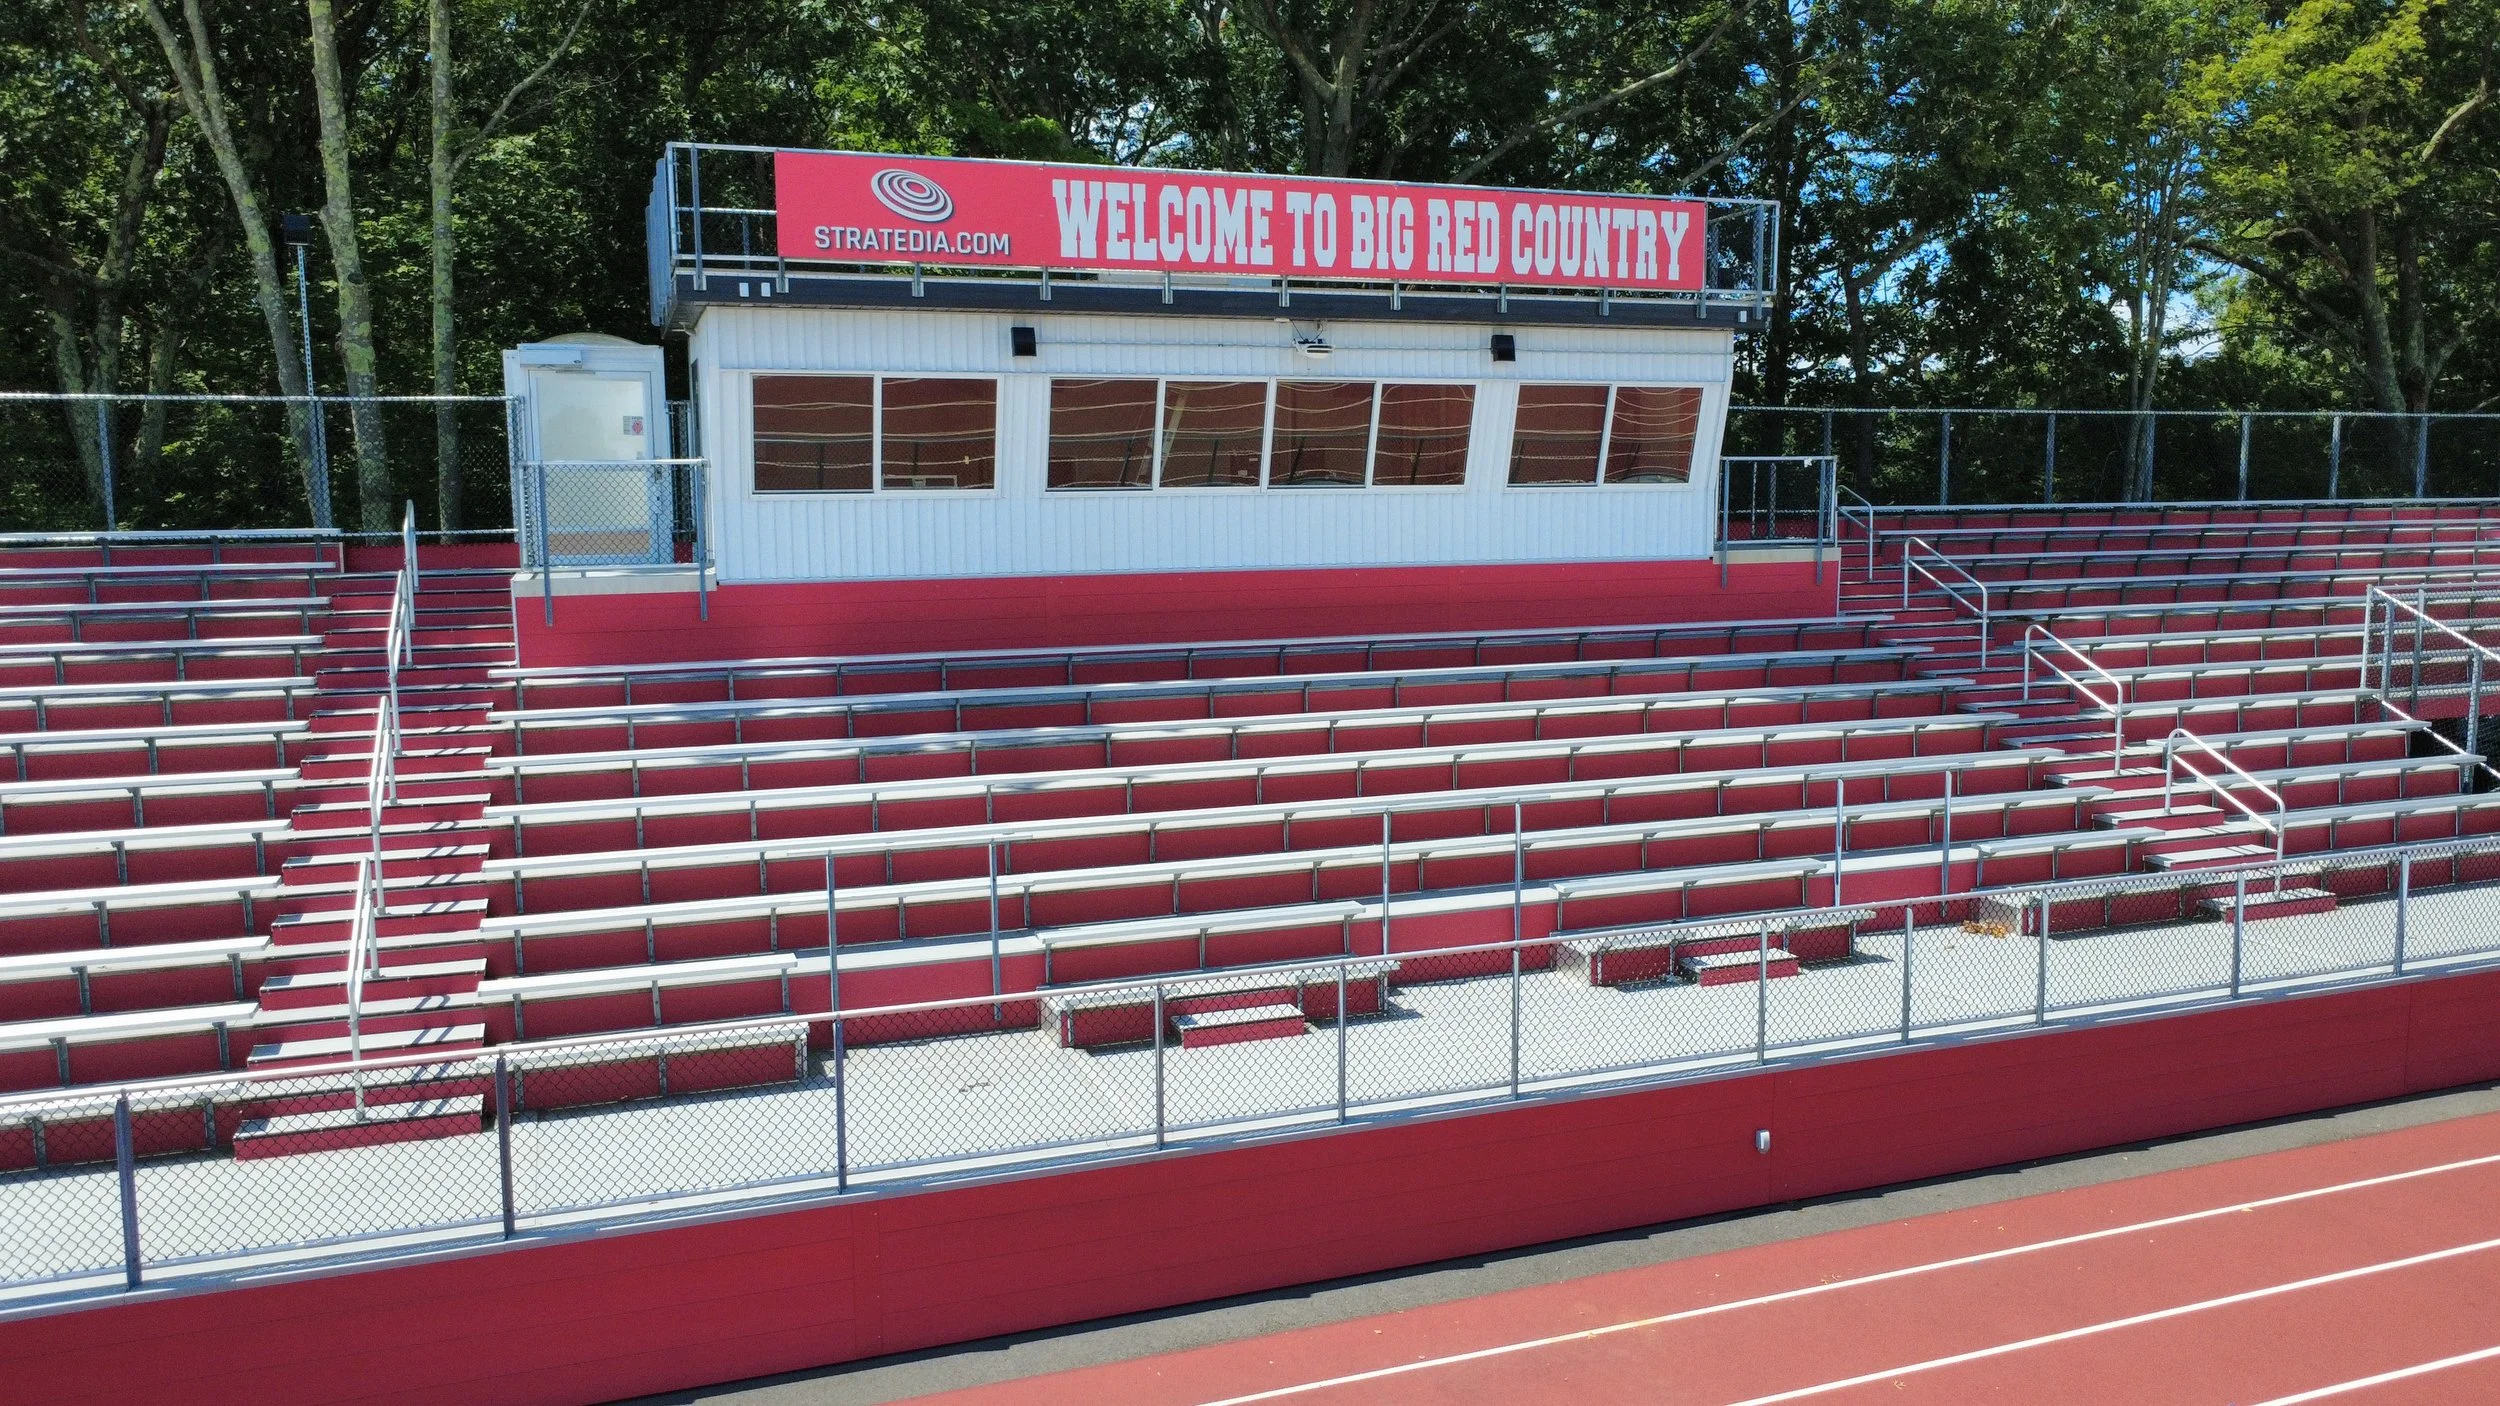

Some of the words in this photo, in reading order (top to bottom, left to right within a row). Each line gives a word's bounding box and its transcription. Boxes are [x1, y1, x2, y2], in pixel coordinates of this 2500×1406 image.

[814, 226, 1010, 256] STRATEDIA.COM
[1052, 179, 1274, 266] WELCOME
[1286, 191, 1337, 268] TO
[1351, 195, 1415, 271] BIG
[1427, 198, 1500, 274] RED
[1511, 203, 1690, 281] COUNTRY
